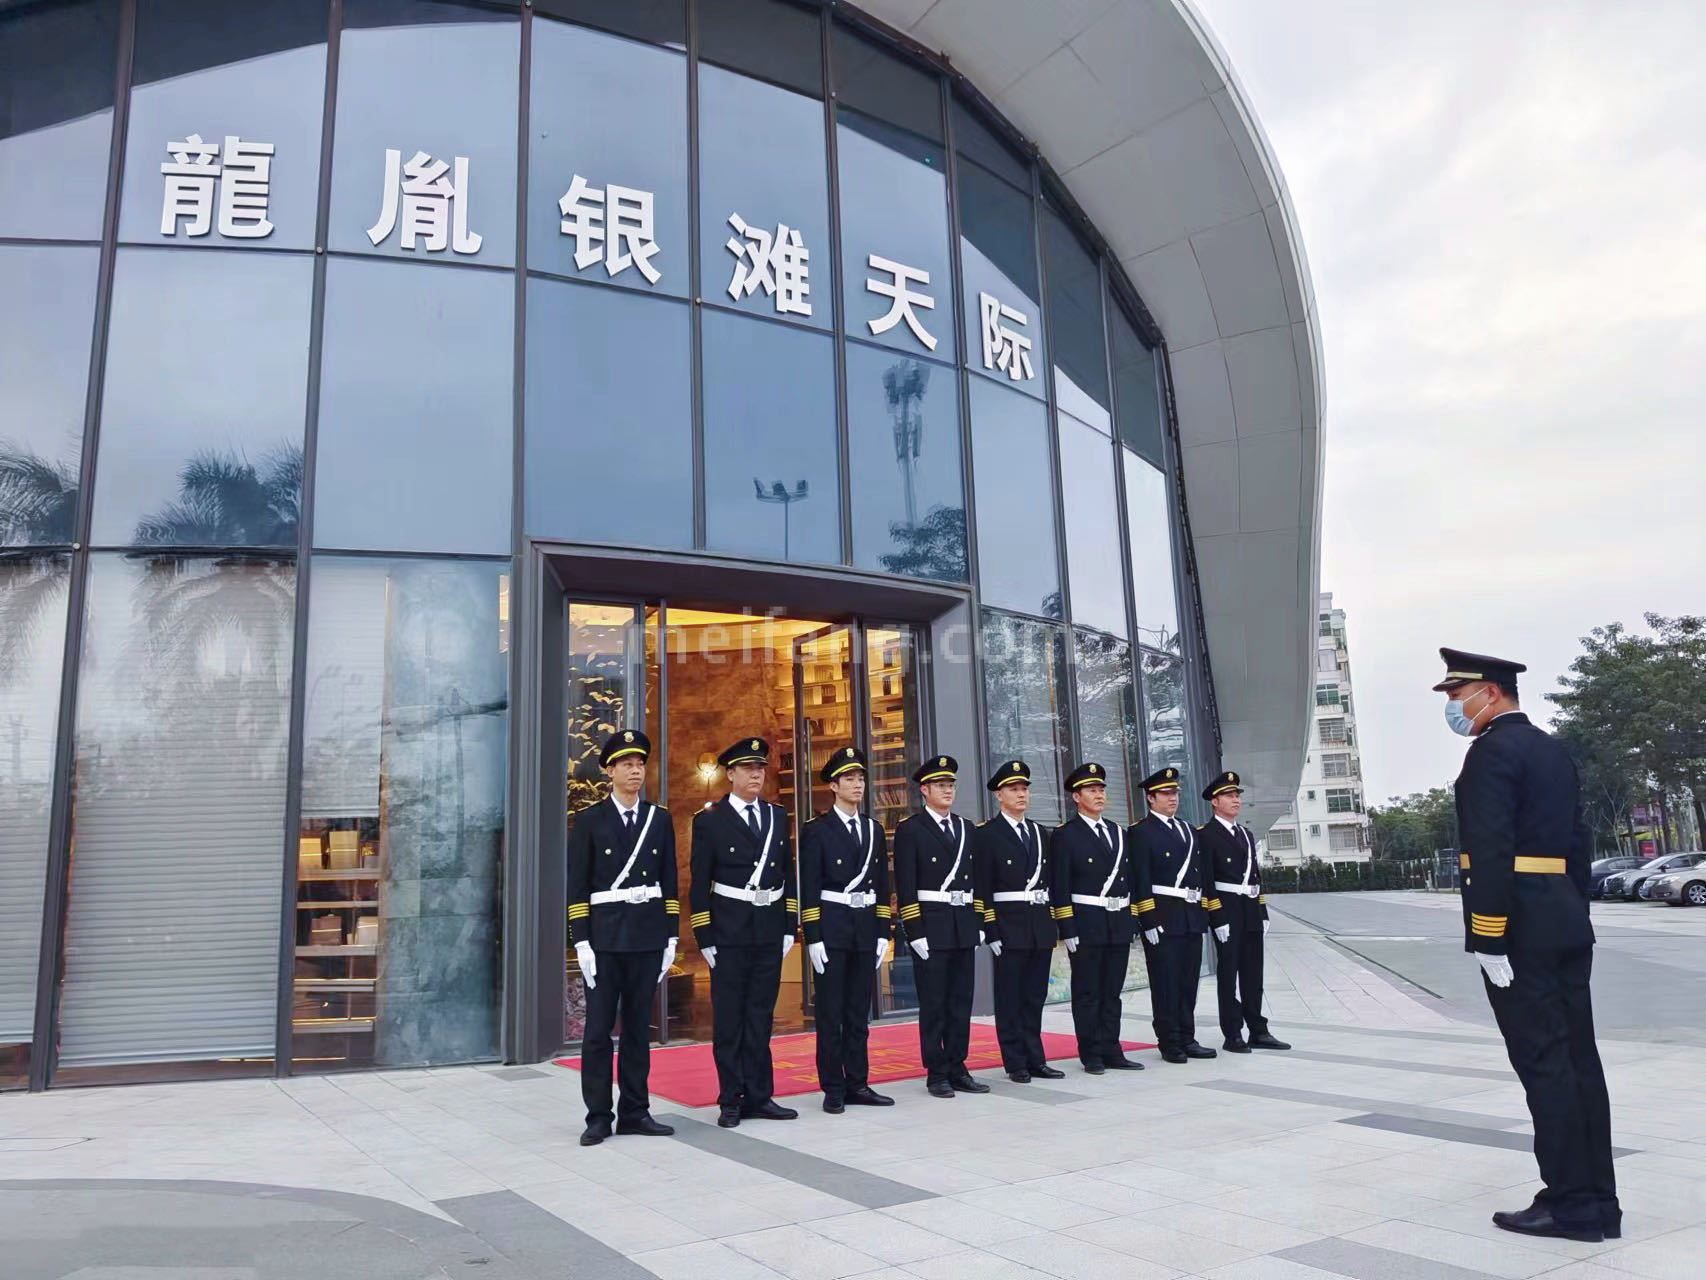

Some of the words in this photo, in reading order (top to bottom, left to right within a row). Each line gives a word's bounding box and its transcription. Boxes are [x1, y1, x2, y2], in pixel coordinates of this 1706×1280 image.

[160, 134, 1042, 381] 龍胤银滩天际
